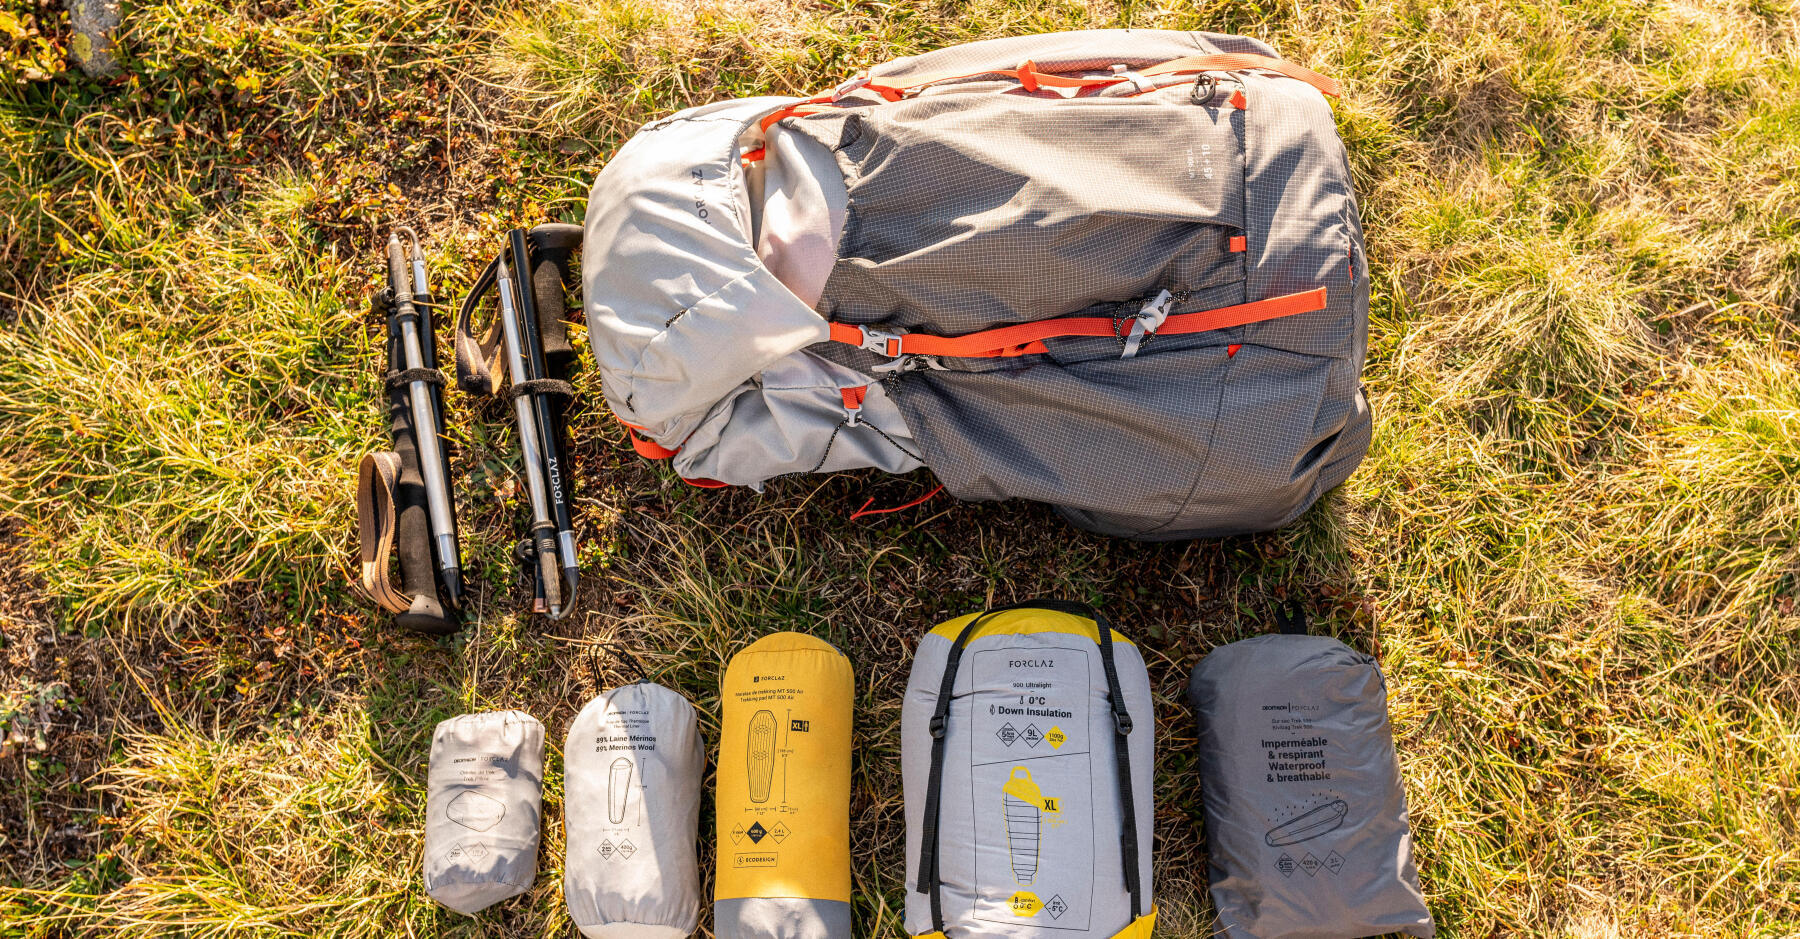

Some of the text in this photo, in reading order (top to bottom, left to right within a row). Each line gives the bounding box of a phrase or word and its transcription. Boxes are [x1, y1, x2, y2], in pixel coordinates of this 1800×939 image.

[691, 169, 711, 225] FORAZ
[548, 456, 564, 505] FORCLAZ
[1009, 659, 1054, 668] FORCLAZ
[1025, 681, 1052, 689] Ultralight
[1028, 696, 1046, 705] 0°C
[998, 705, 1072, 719] Down Insulation
[792, 722, 802, 730] XL
[1027, 729, 1038, 737] 9L
[595, 736, 608, 744] 89%
[1261, 737, 1328, 750] Imperméable
[1268, 750, 1324, 761] & respirant
[1268, 760, 1326, 772] Waterproof
[1266, 772, 1331, 783] & breathable
[1044, 799, 1056, 811] XL
